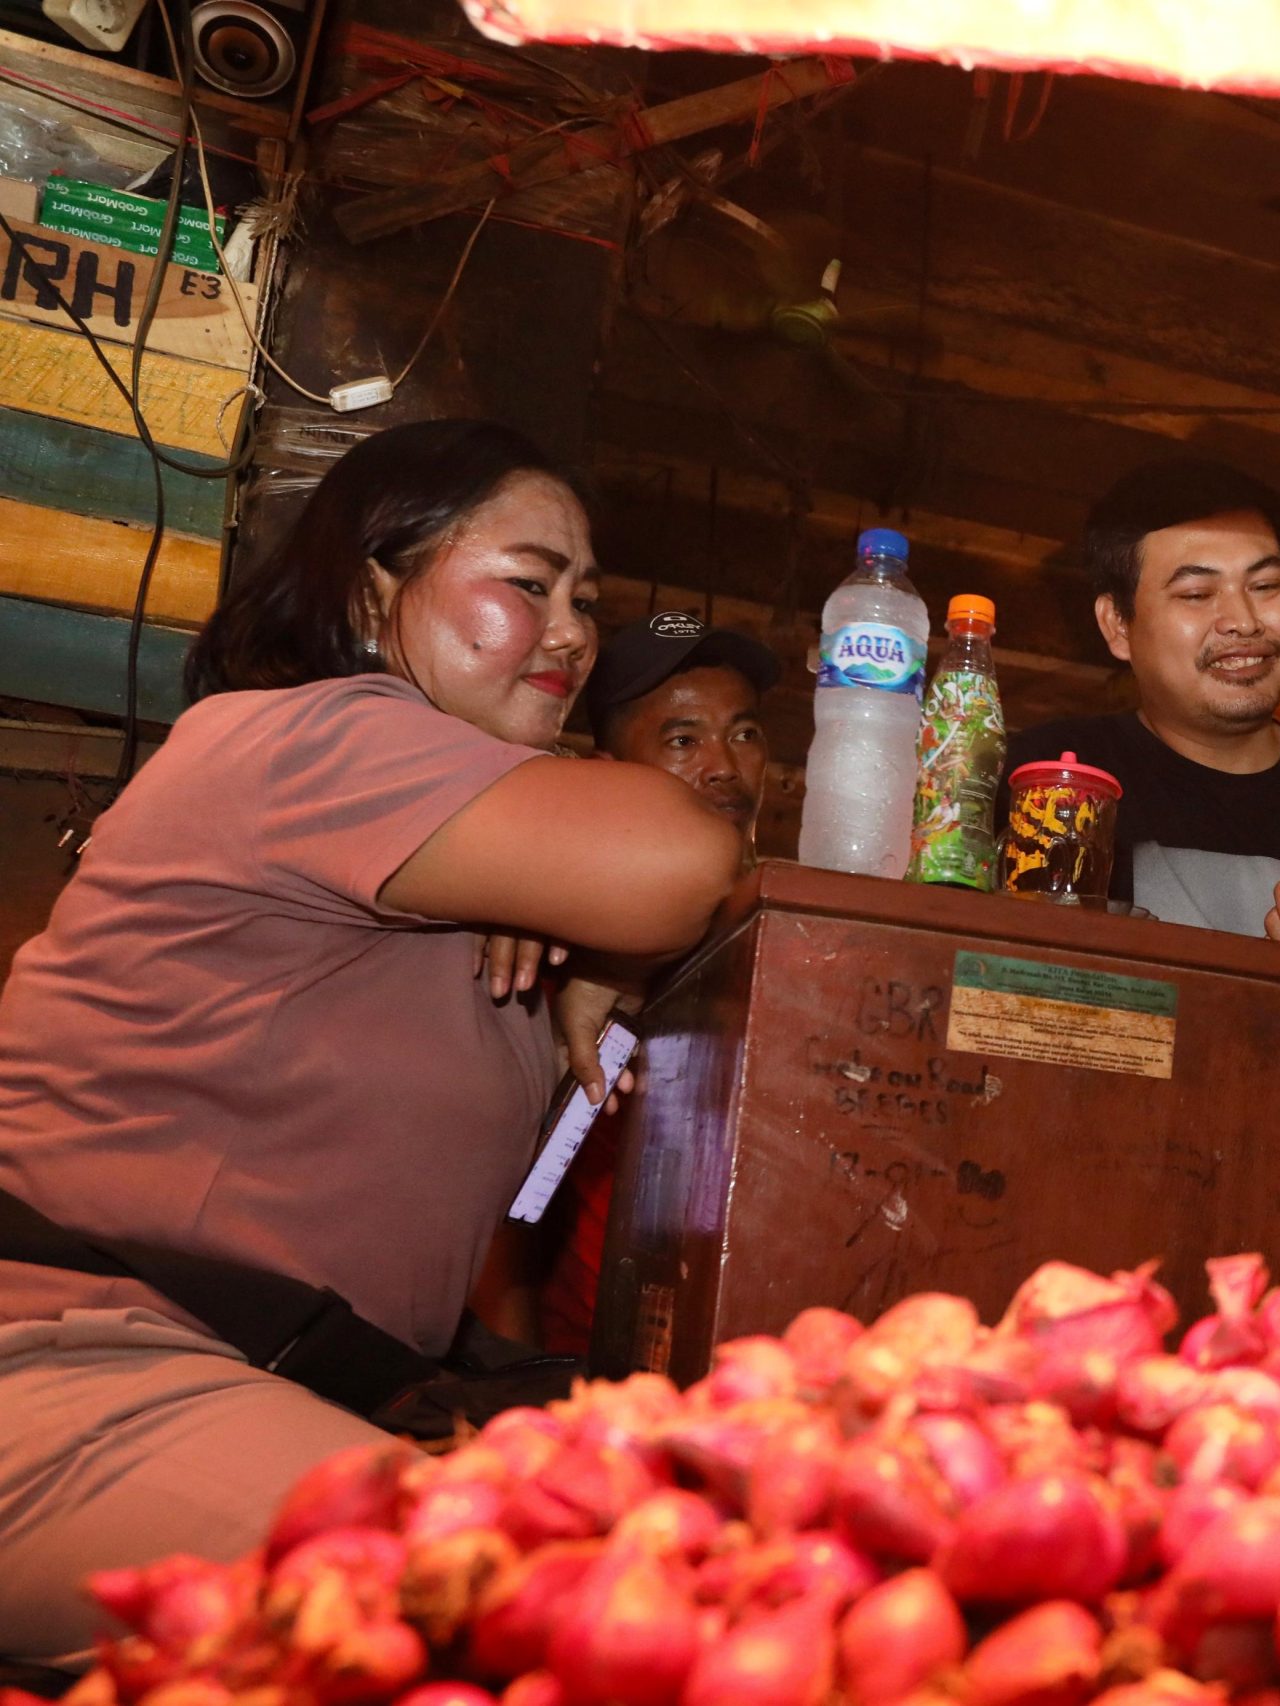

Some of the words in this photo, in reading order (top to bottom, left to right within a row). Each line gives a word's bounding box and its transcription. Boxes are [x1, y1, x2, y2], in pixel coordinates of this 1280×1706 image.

[52, 201, 113, 225] GrabMart
[87, 192, 148, 216] GrabMart
[60, 225, 122, 247] GrabMart
[657, 622, 701, 631] OAKLEY
[838, 634, 905, 663] AQUA
